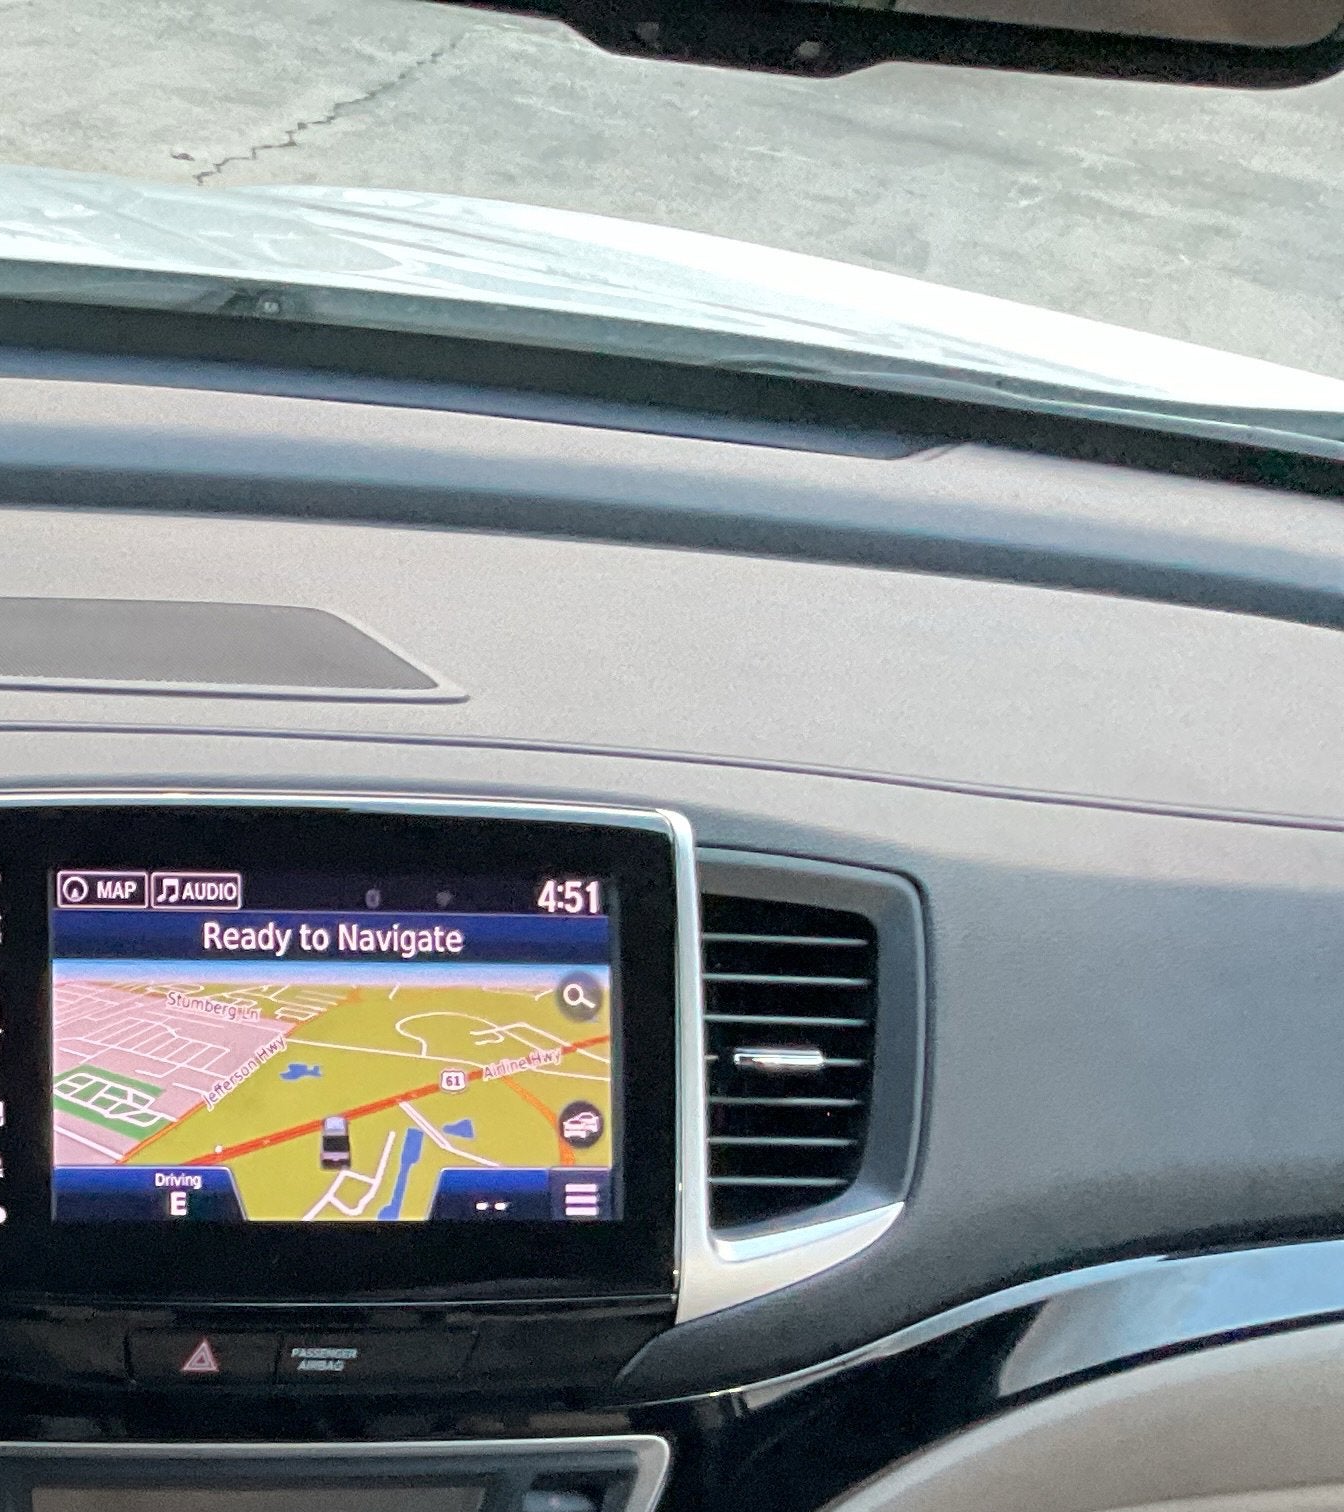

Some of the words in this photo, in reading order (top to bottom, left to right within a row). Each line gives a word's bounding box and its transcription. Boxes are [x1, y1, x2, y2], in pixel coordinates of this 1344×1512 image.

[96, 881, 137, 900] MAP
[181, 881, 238, 901] AUDIO
[537, 879, 600, 914] 4:51
[203, 921, 292, 956] Ready
[300, 924, 330, 951] to
[337, 924, 464, 958] Navigate
[167, 991, 237, 1020] Stumberg
[203, 1058, 258, 1107] Jefferson
[256, 1036, 287, 1061] Hwy
[484, 1059, 528, 1079] Airline
[530, 1050, 561, 1065] Hwy
[445, 1075, 461, 1087] 61
[155, 1173, 203, 1189] Driving
[170, 1192, 187, 1216] E
[291, 1347, 358, 1359] PASSENGER
